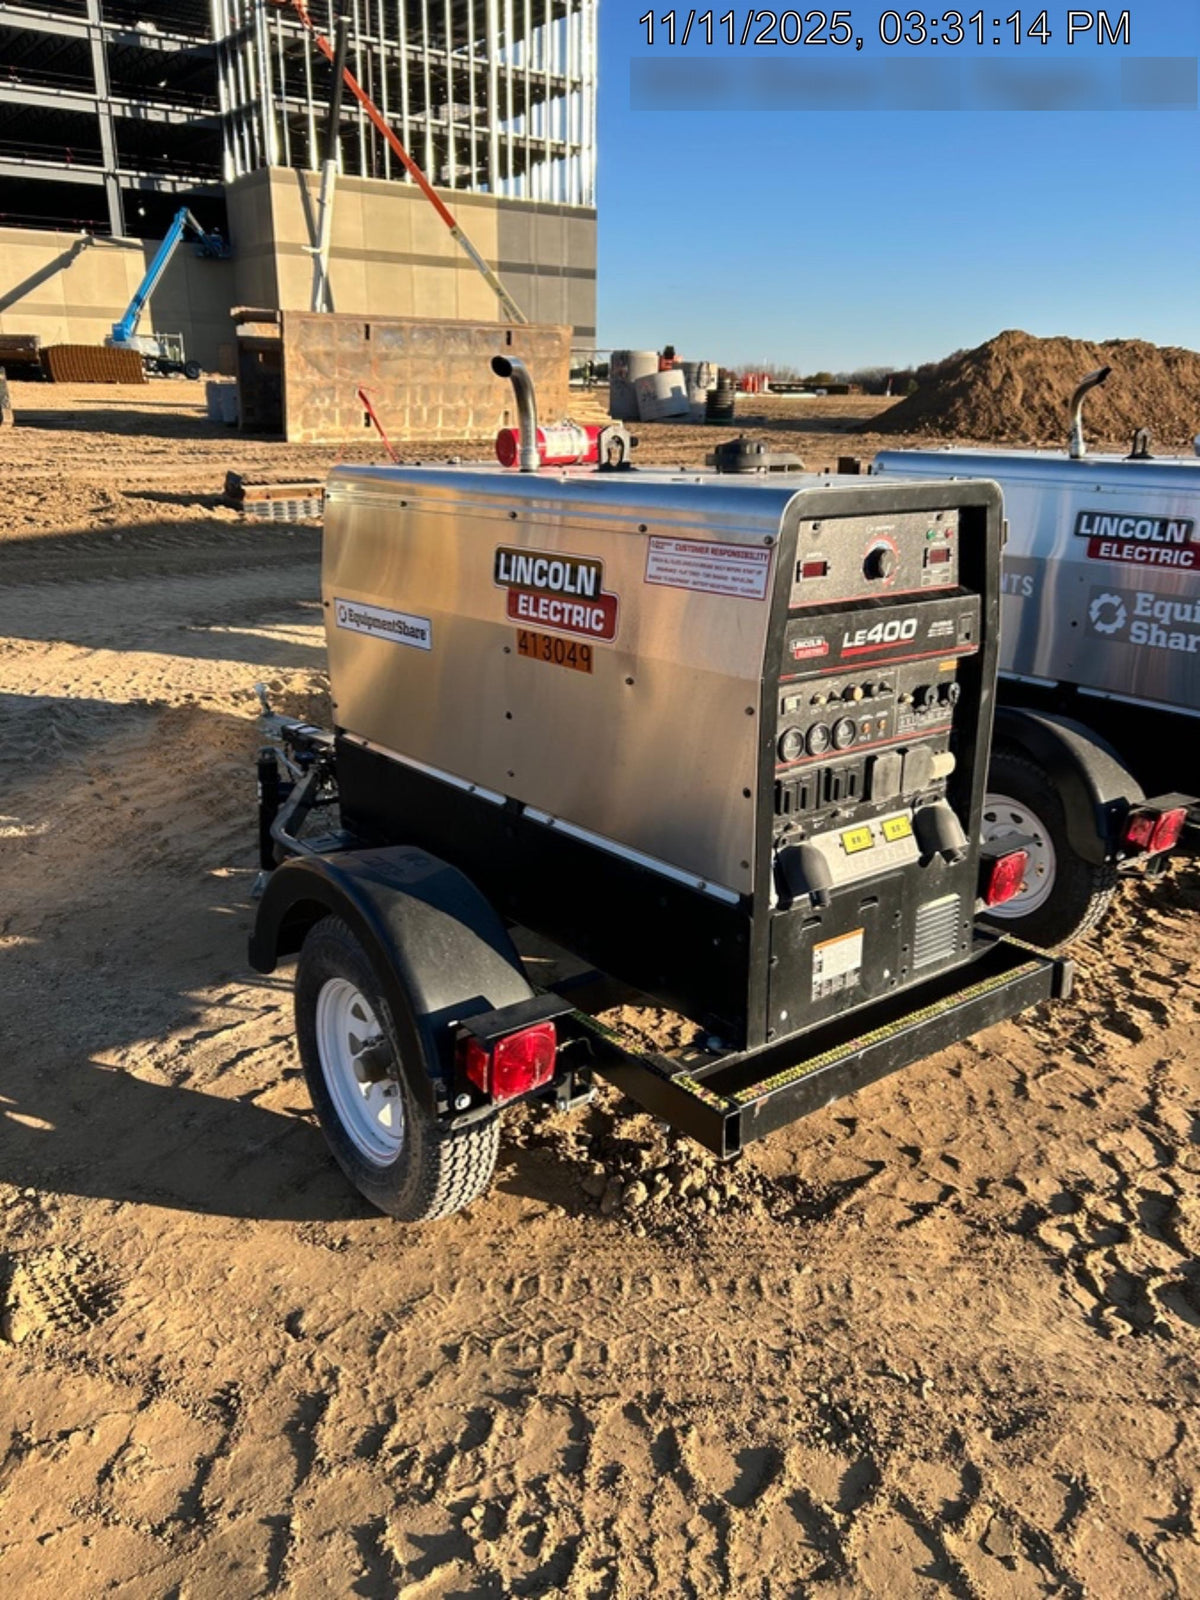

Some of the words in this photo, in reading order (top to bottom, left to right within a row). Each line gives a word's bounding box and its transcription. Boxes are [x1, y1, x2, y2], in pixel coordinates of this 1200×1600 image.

[1079, 514, 1187, 543] LINCOLN
[1099, 542, 1195, 567] ELECTRIC
[498, 553, 597, 596] LINCOLN
[348, 608, 427, 641] EquipmentShare
[517, 594, 605, 632] ELECTRIC
[842, 618, 918, 648] LE400
[518, 631, 592, 671] 413049
